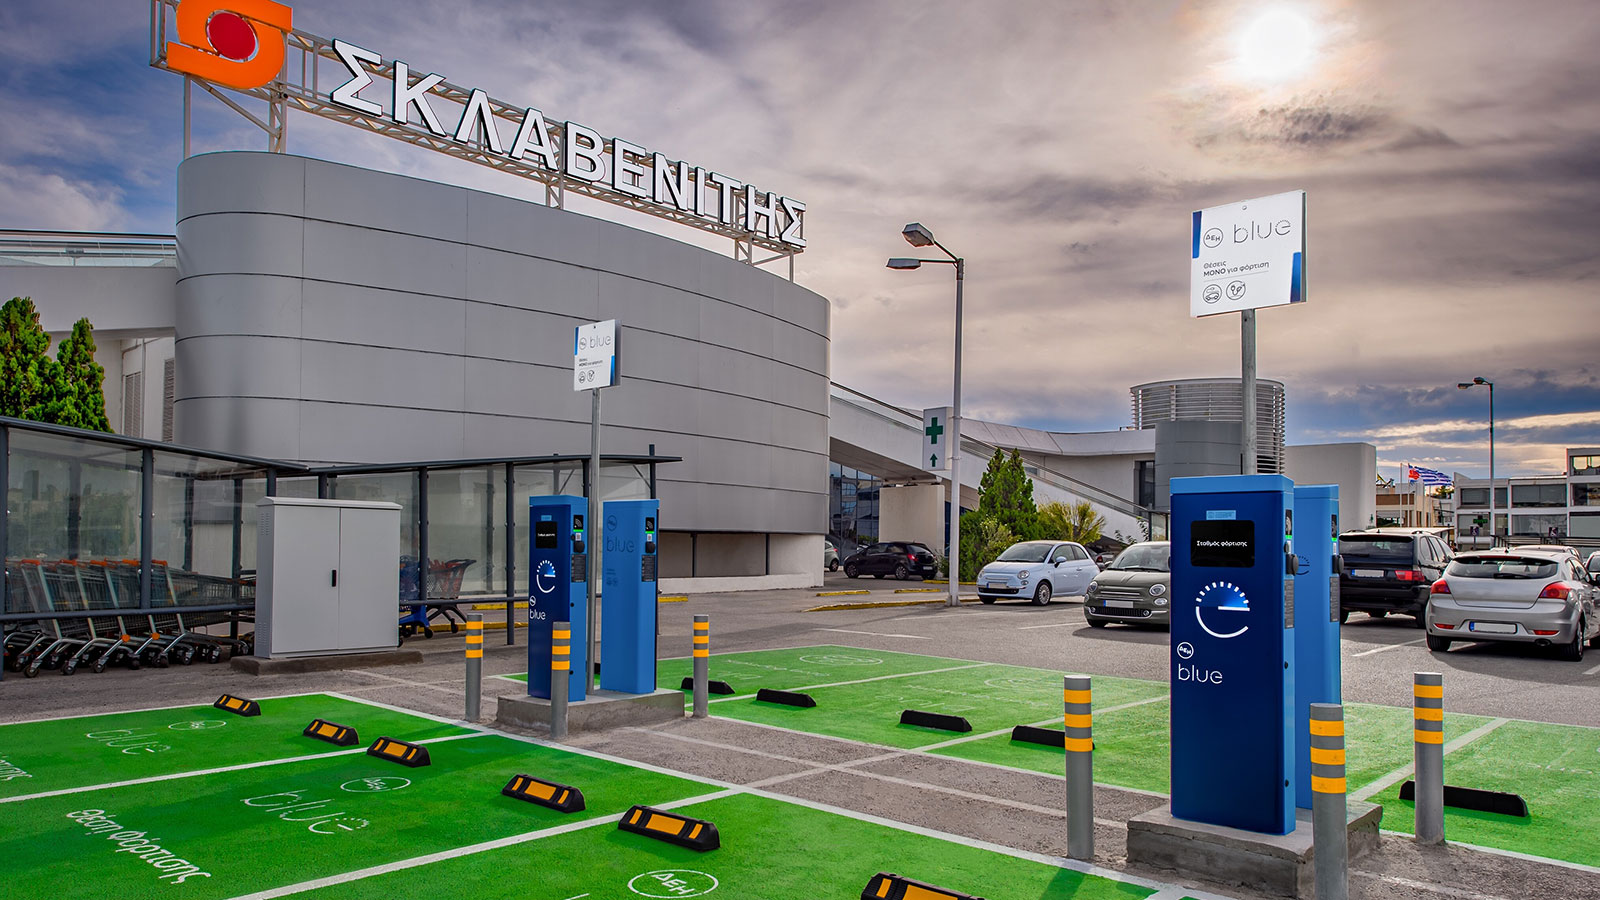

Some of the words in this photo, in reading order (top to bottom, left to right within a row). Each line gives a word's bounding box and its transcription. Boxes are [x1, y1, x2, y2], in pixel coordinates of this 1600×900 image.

[331, 39, 806, 248] ΣΚΛΑΒΕΝΙΤΗΣ
[1233, 219, 1291, 244] blue
[1203, 268, 1227, 277] ΜΟΝΟ
[529, 608, 546, 620] blue
[1178, 663, 1223, 684] blue
[240, 789, 369, 835] blue
